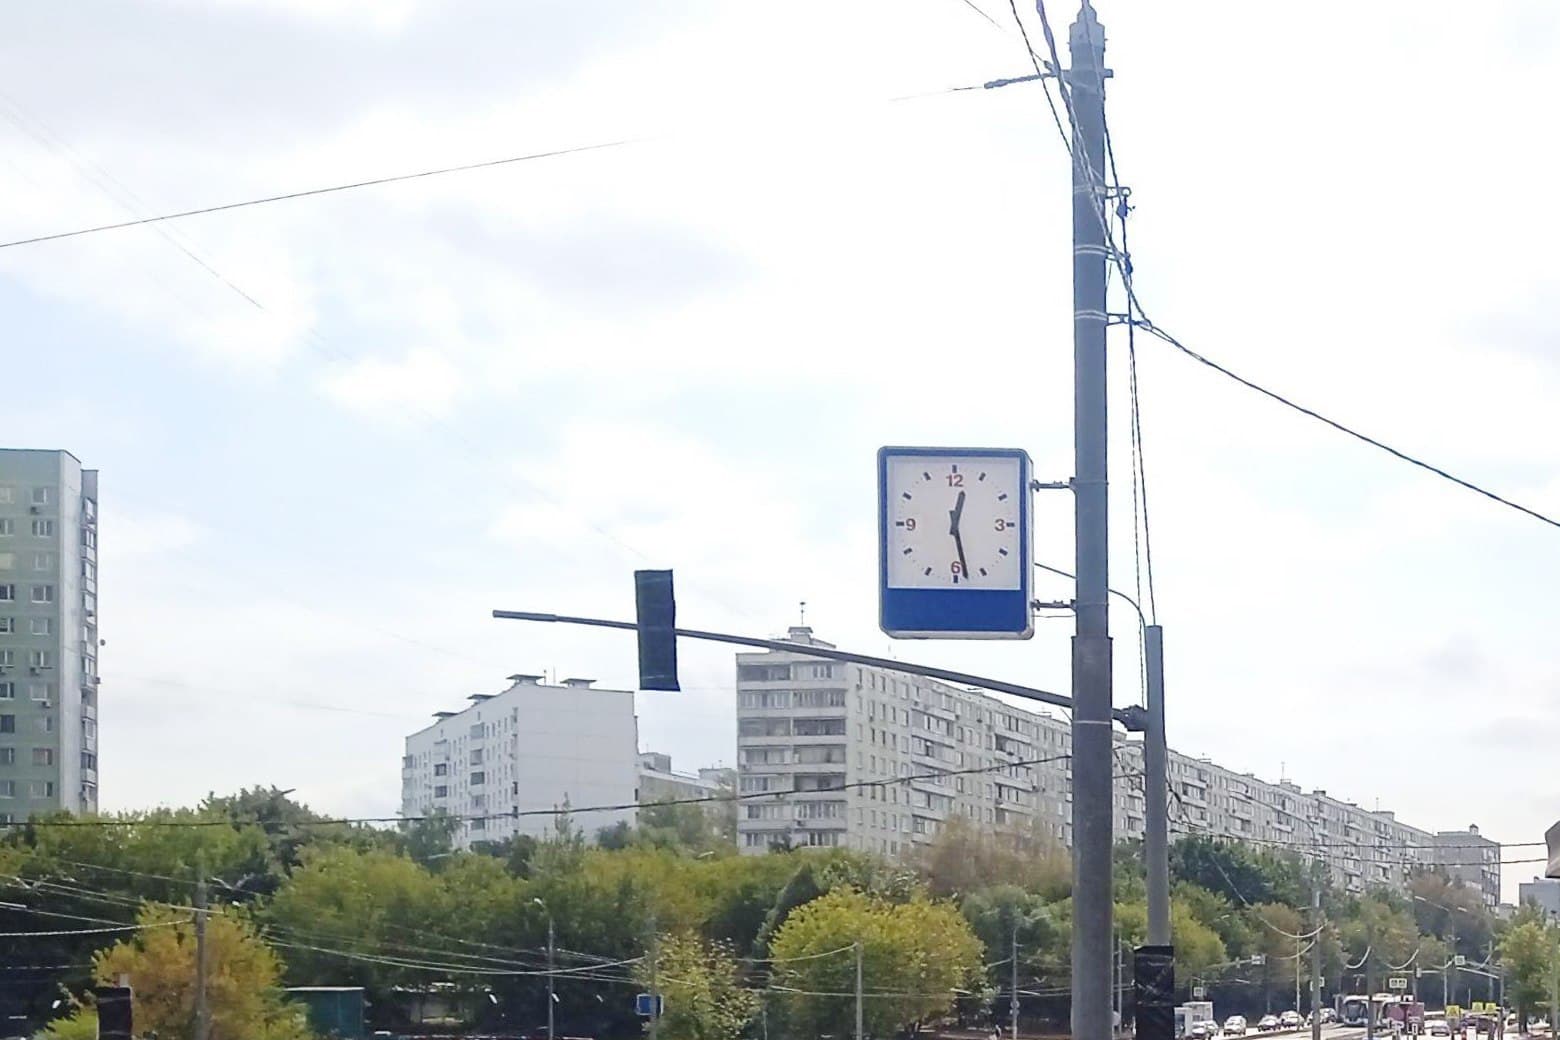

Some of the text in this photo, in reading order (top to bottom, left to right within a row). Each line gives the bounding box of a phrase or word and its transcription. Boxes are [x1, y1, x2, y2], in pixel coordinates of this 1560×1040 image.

[946, 474, 964, 487] 12
[906, 518, 916, 531] 9
[994, 519, 1005, 531] 3
[951, 561, 961, 573] 6
